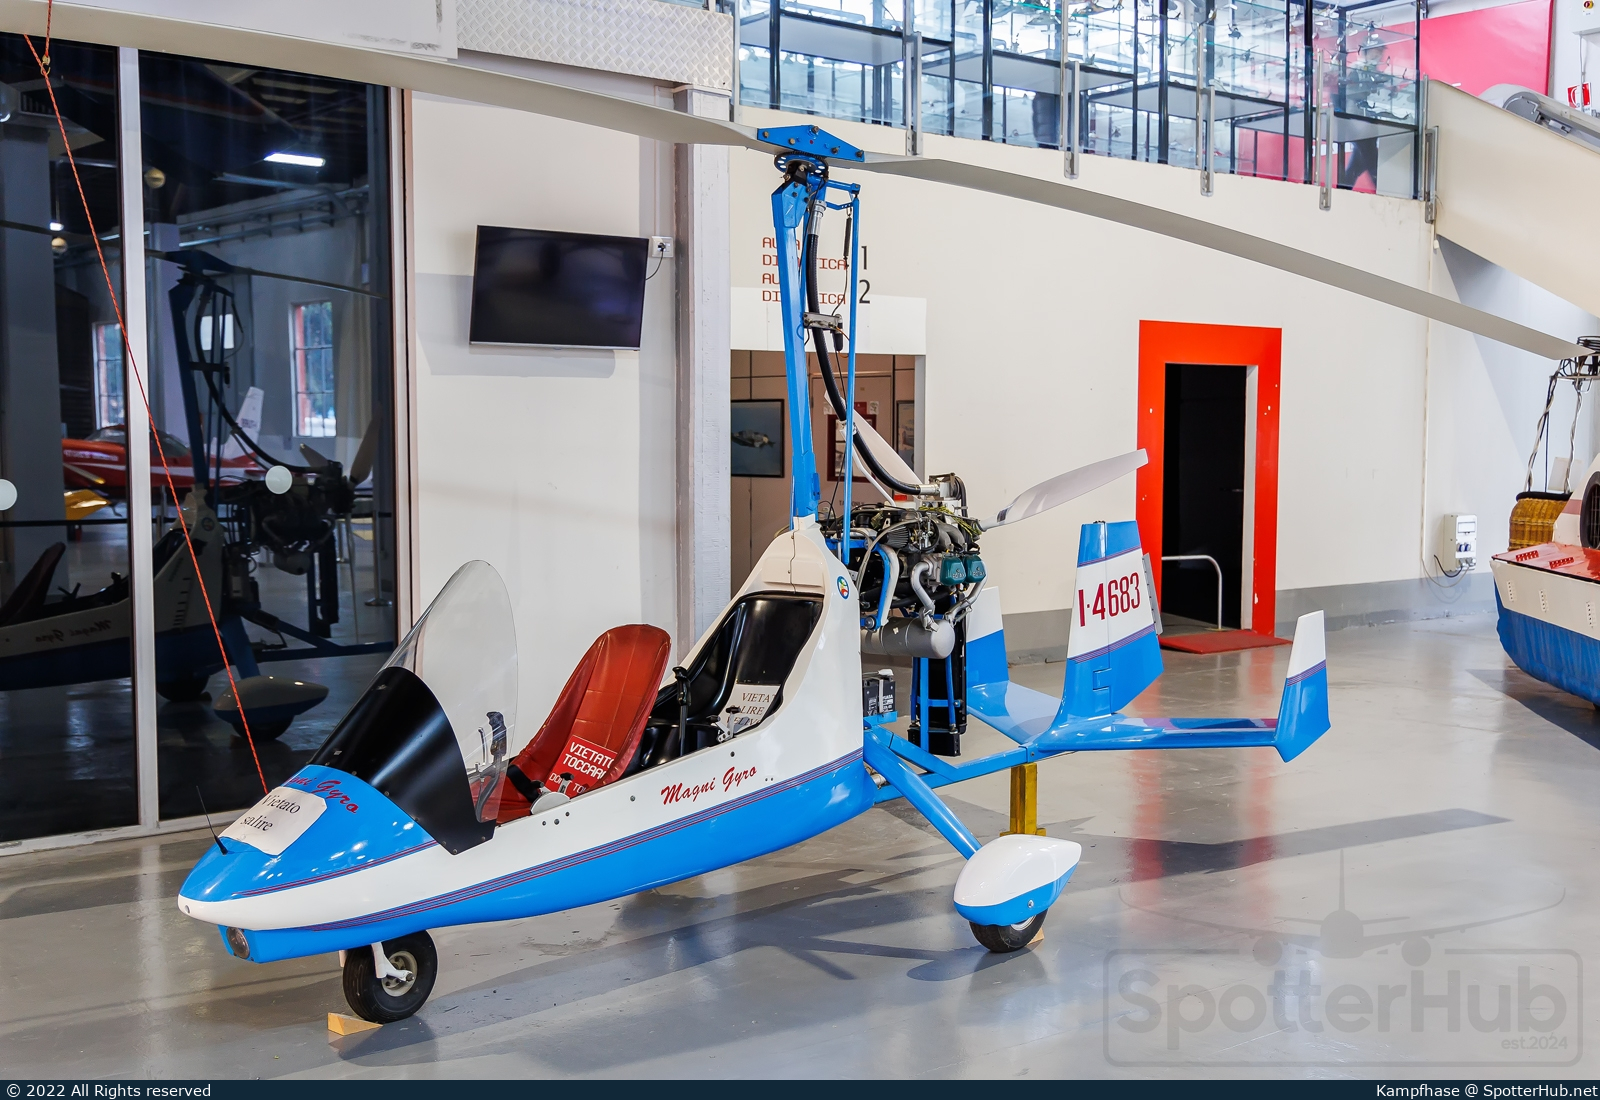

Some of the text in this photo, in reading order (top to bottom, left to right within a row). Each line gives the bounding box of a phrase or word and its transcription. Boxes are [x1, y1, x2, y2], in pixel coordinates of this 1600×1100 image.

[861, 245, 868, 270] 1
[858, 279, 871, 304] 2
[311, 780, 359, 814] Gyro
[660, 766, 757, 805] Magni Gyro
[261, 794, 301, 814] Vietato
[240, 815, 274, 832] salire
